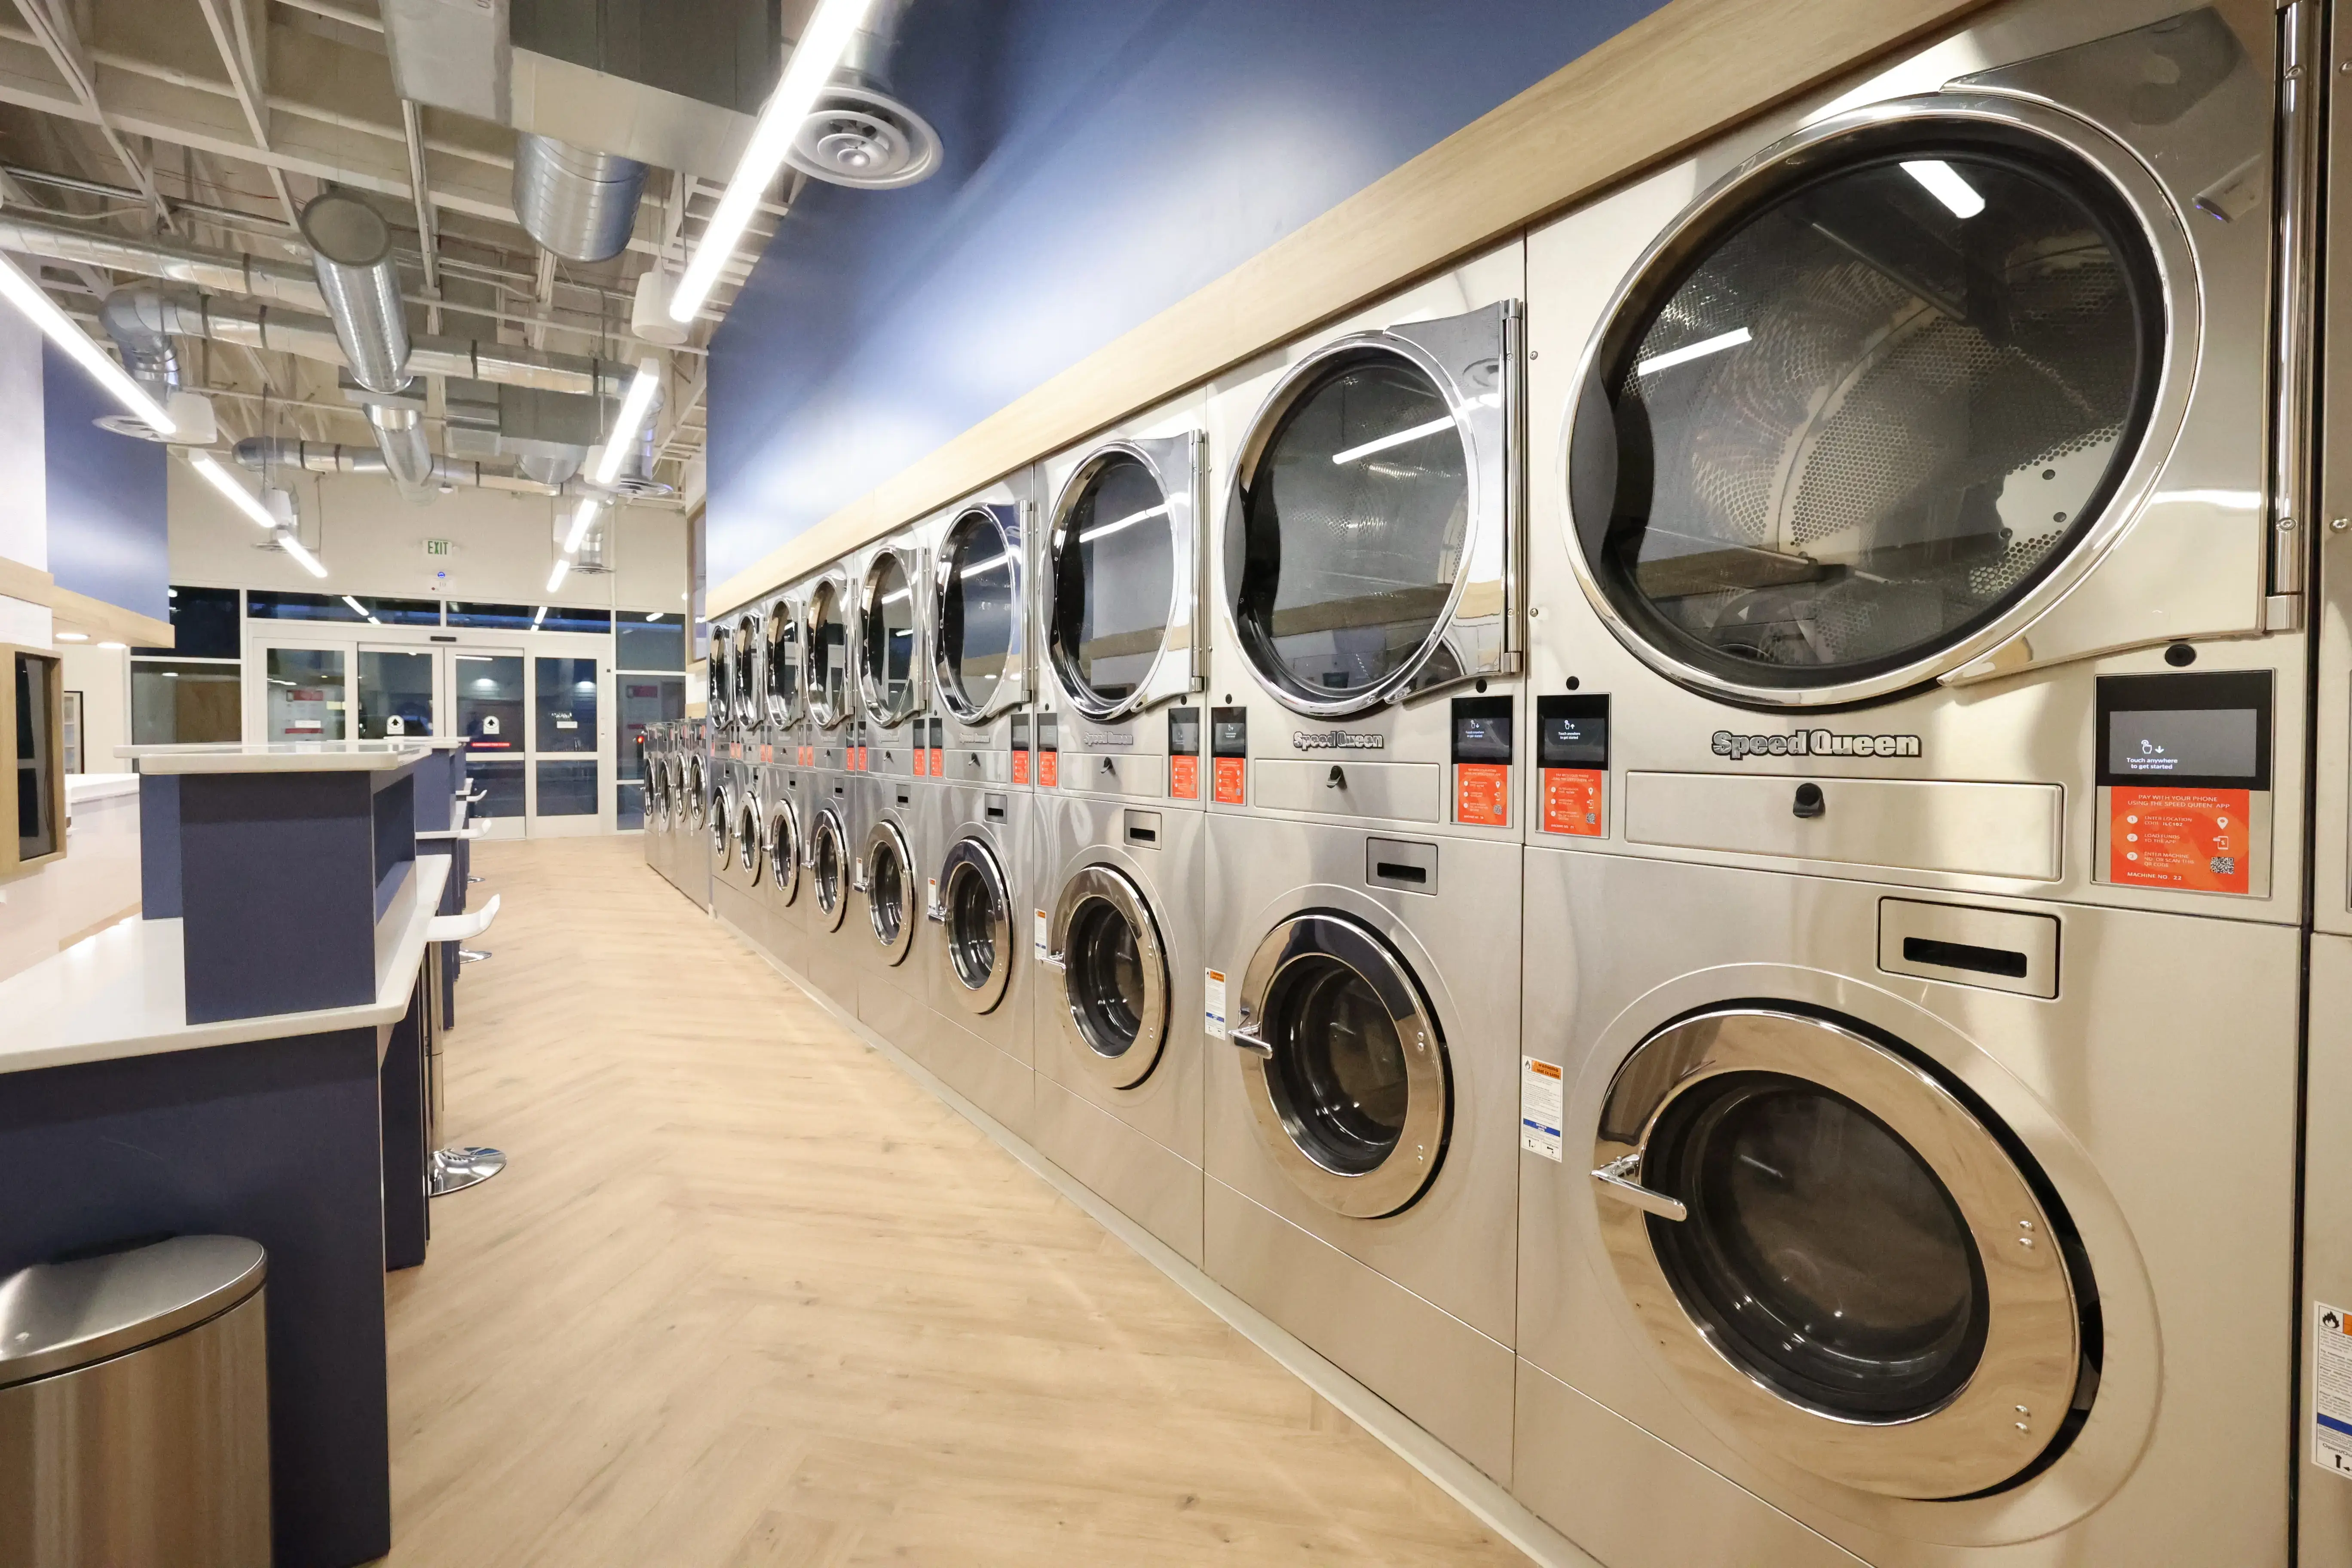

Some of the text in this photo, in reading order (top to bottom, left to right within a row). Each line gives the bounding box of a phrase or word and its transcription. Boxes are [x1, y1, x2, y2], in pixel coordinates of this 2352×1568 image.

[428, 541, 448, 555] EXIT
[1293, 731, 1384, 751] Speed Queen
[1712, 729, 1922, 760] Speed Queen
